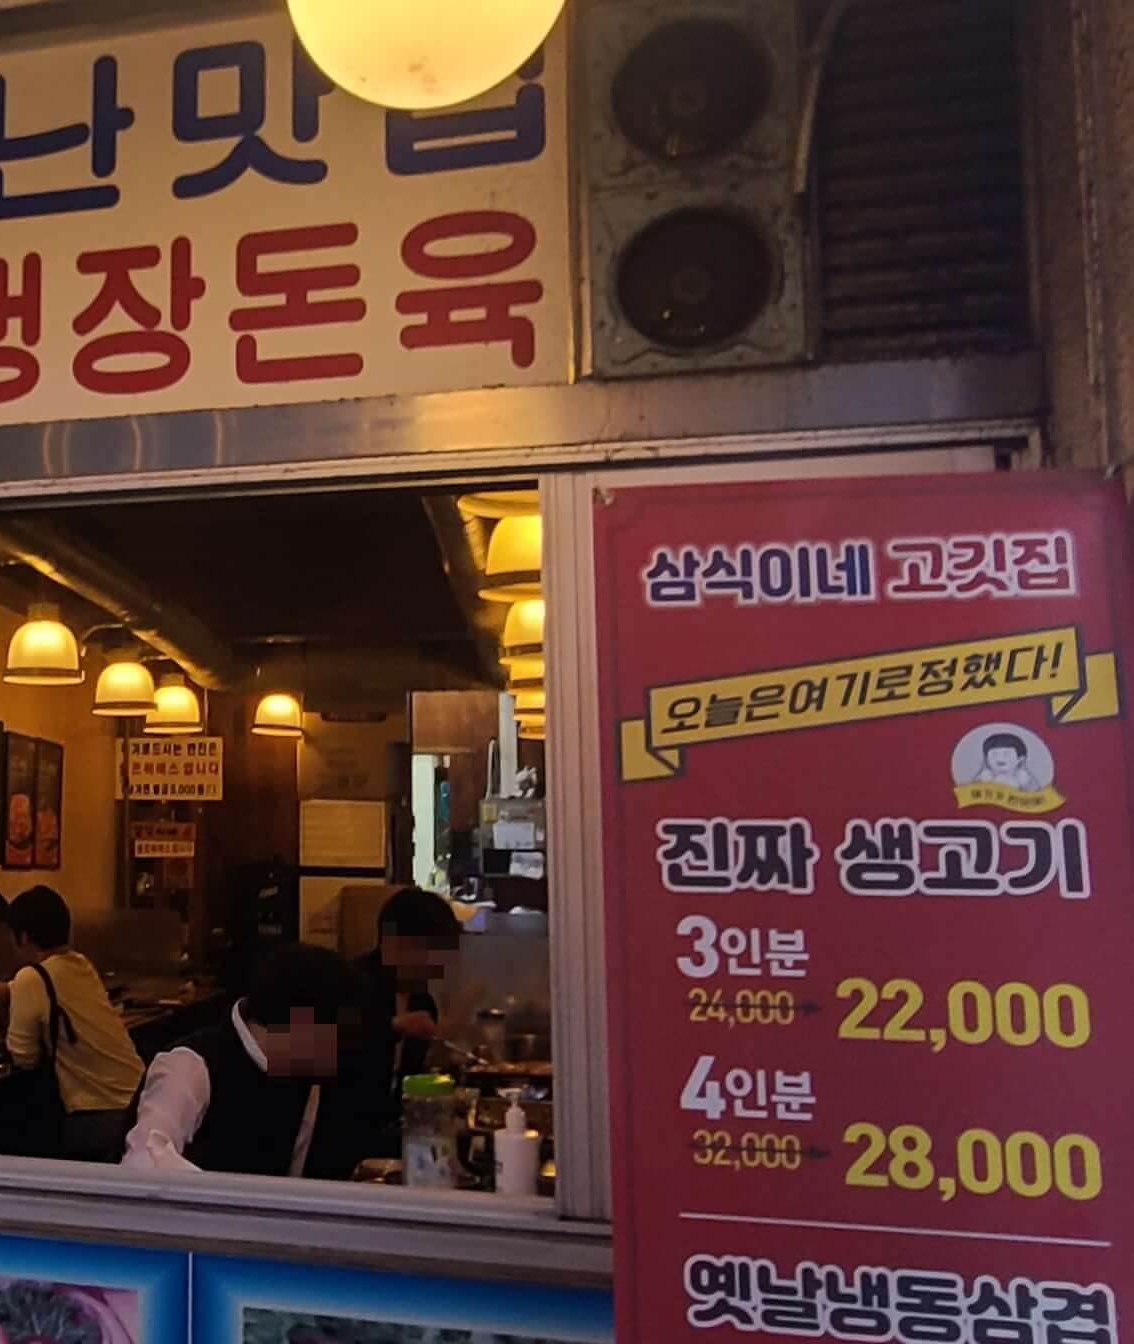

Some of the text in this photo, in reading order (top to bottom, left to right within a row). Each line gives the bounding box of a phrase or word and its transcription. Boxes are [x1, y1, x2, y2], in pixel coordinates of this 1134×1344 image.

[645, 532, 1075, 606] 삼식이네 고깃집
[656, 816, 1092, 899] 진짜 생고기
[675, 915, 810, 978] 3인분
[688, 979, 1091, 1053] 24,000 22,000
[679, 1056, 816, 1121] 4인분
[692, 1123, 1103, 1201] 32,000 28,000
